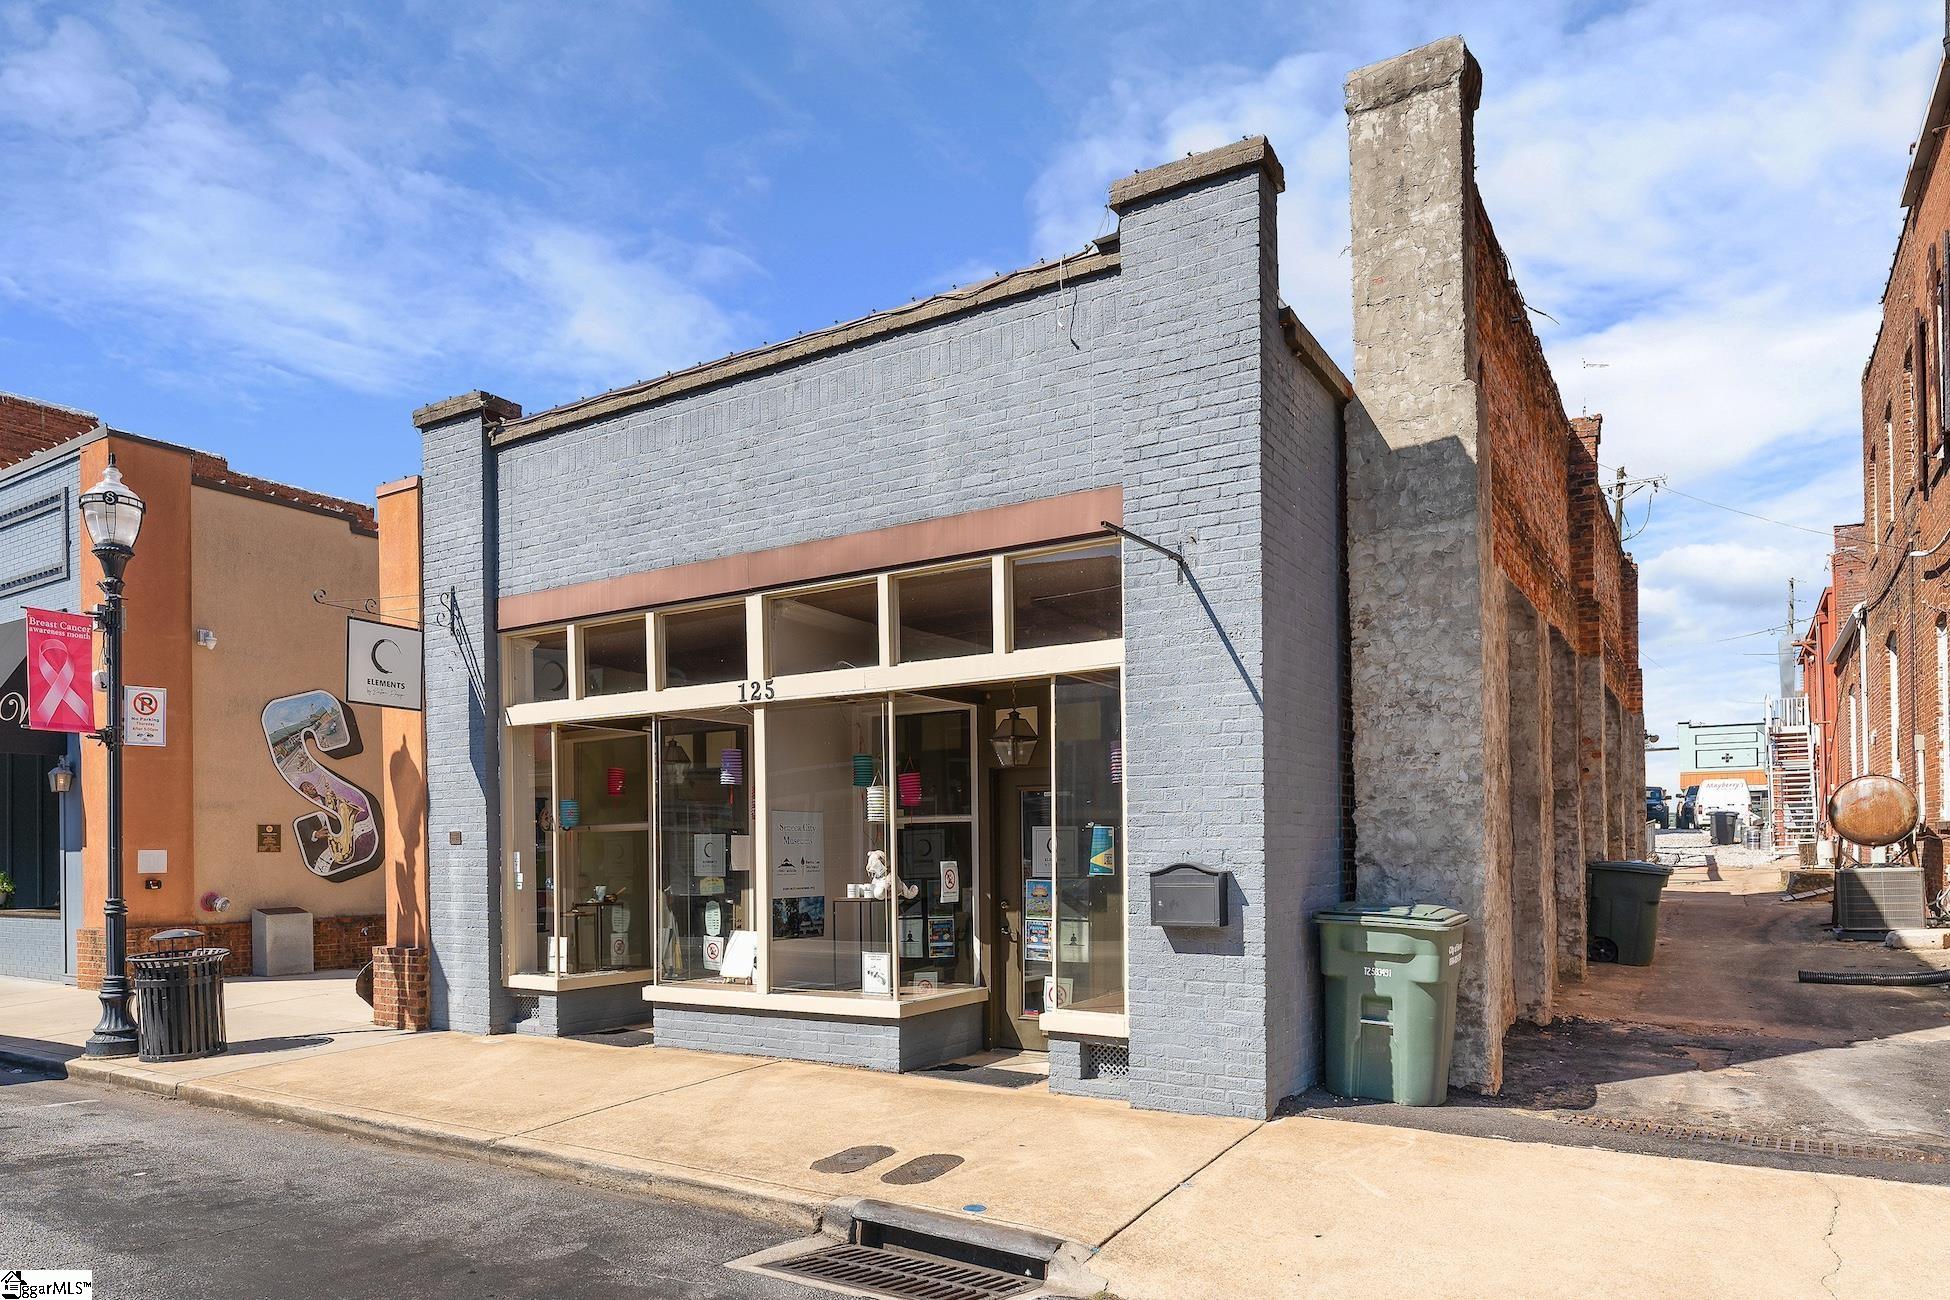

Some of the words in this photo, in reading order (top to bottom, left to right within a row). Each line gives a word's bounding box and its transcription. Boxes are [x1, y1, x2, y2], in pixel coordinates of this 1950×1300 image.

[105, 491, 115, 504] S
[29, 616, 58, 629] Breast
[60, 621, 91, 633] Cancer
[29, 627, 65, 637] awareness
[67, 631, 91, 640] month
[367, 678, 406, 690] ELEMENTS
[737, 680, 775, 702] 125
